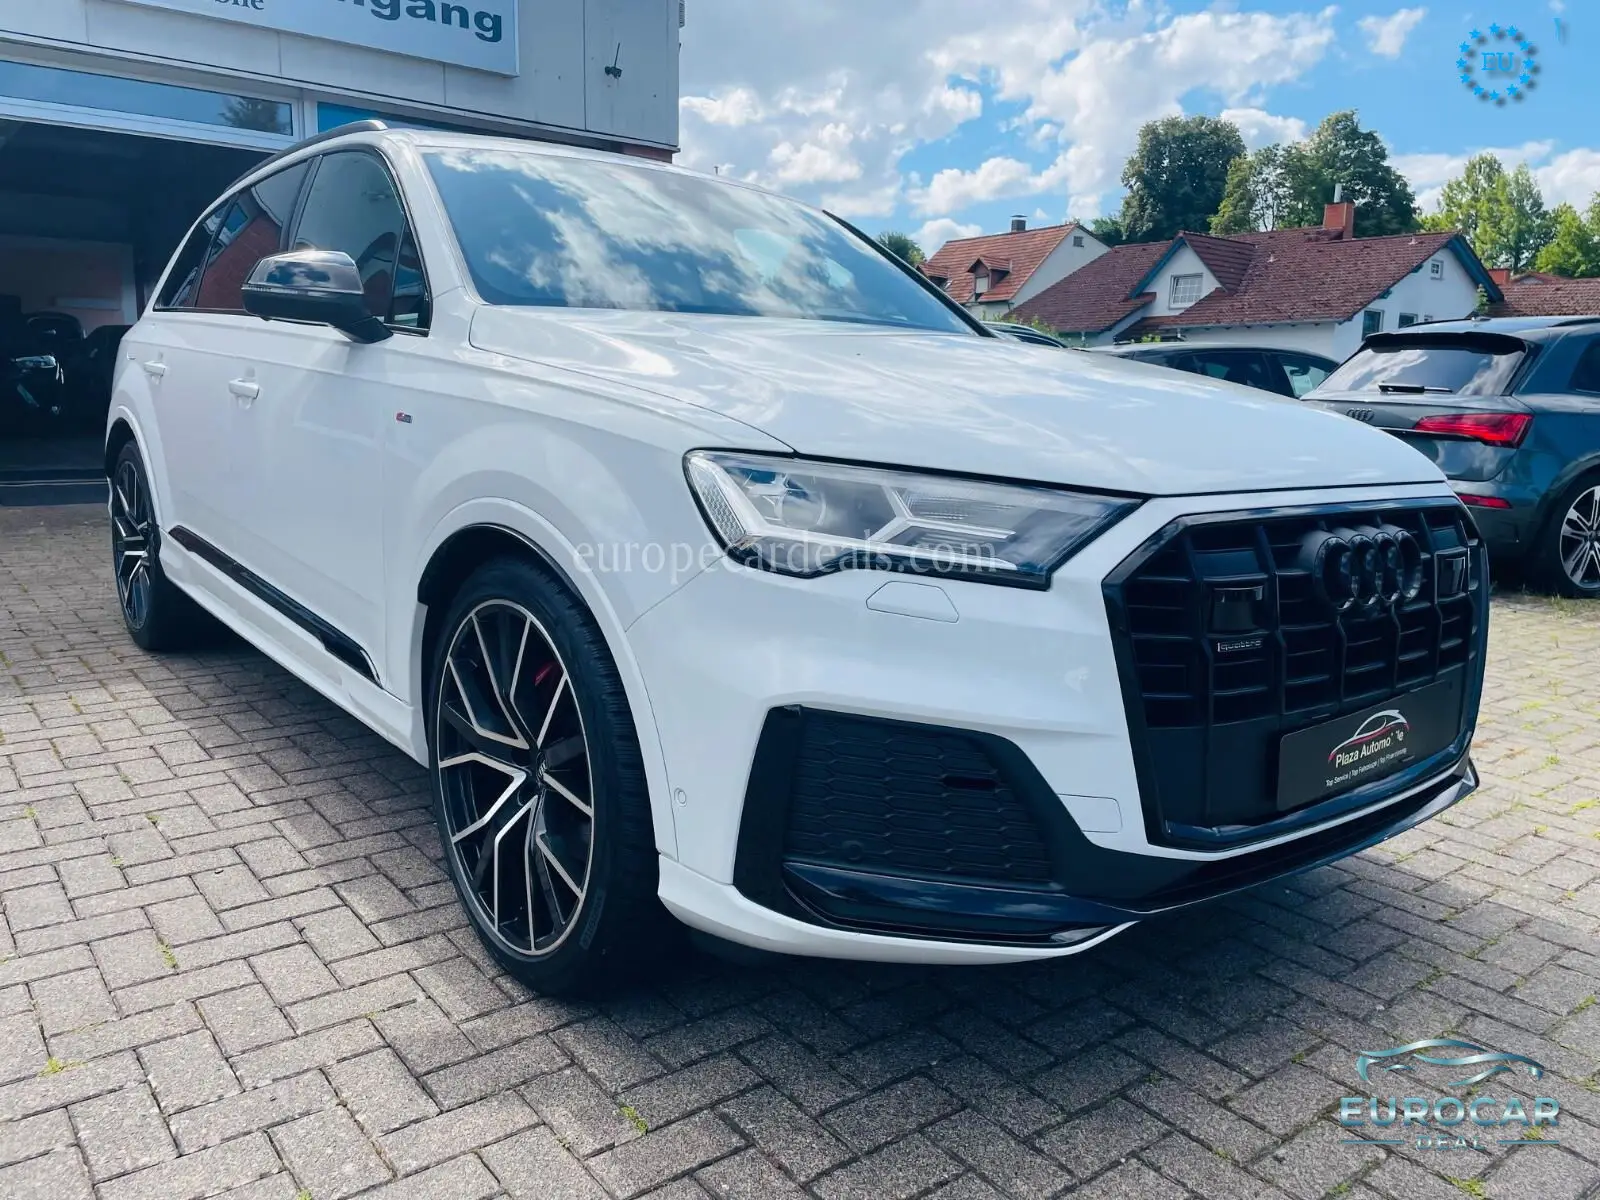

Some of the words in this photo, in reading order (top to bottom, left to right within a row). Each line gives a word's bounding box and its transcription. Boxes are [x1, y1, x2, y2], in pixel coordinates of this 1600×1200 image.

[338, 0, 502, 43] gang
[1335, 749, 1359, 768] Plaza
[1360, 730, 1404, 758] Automole
